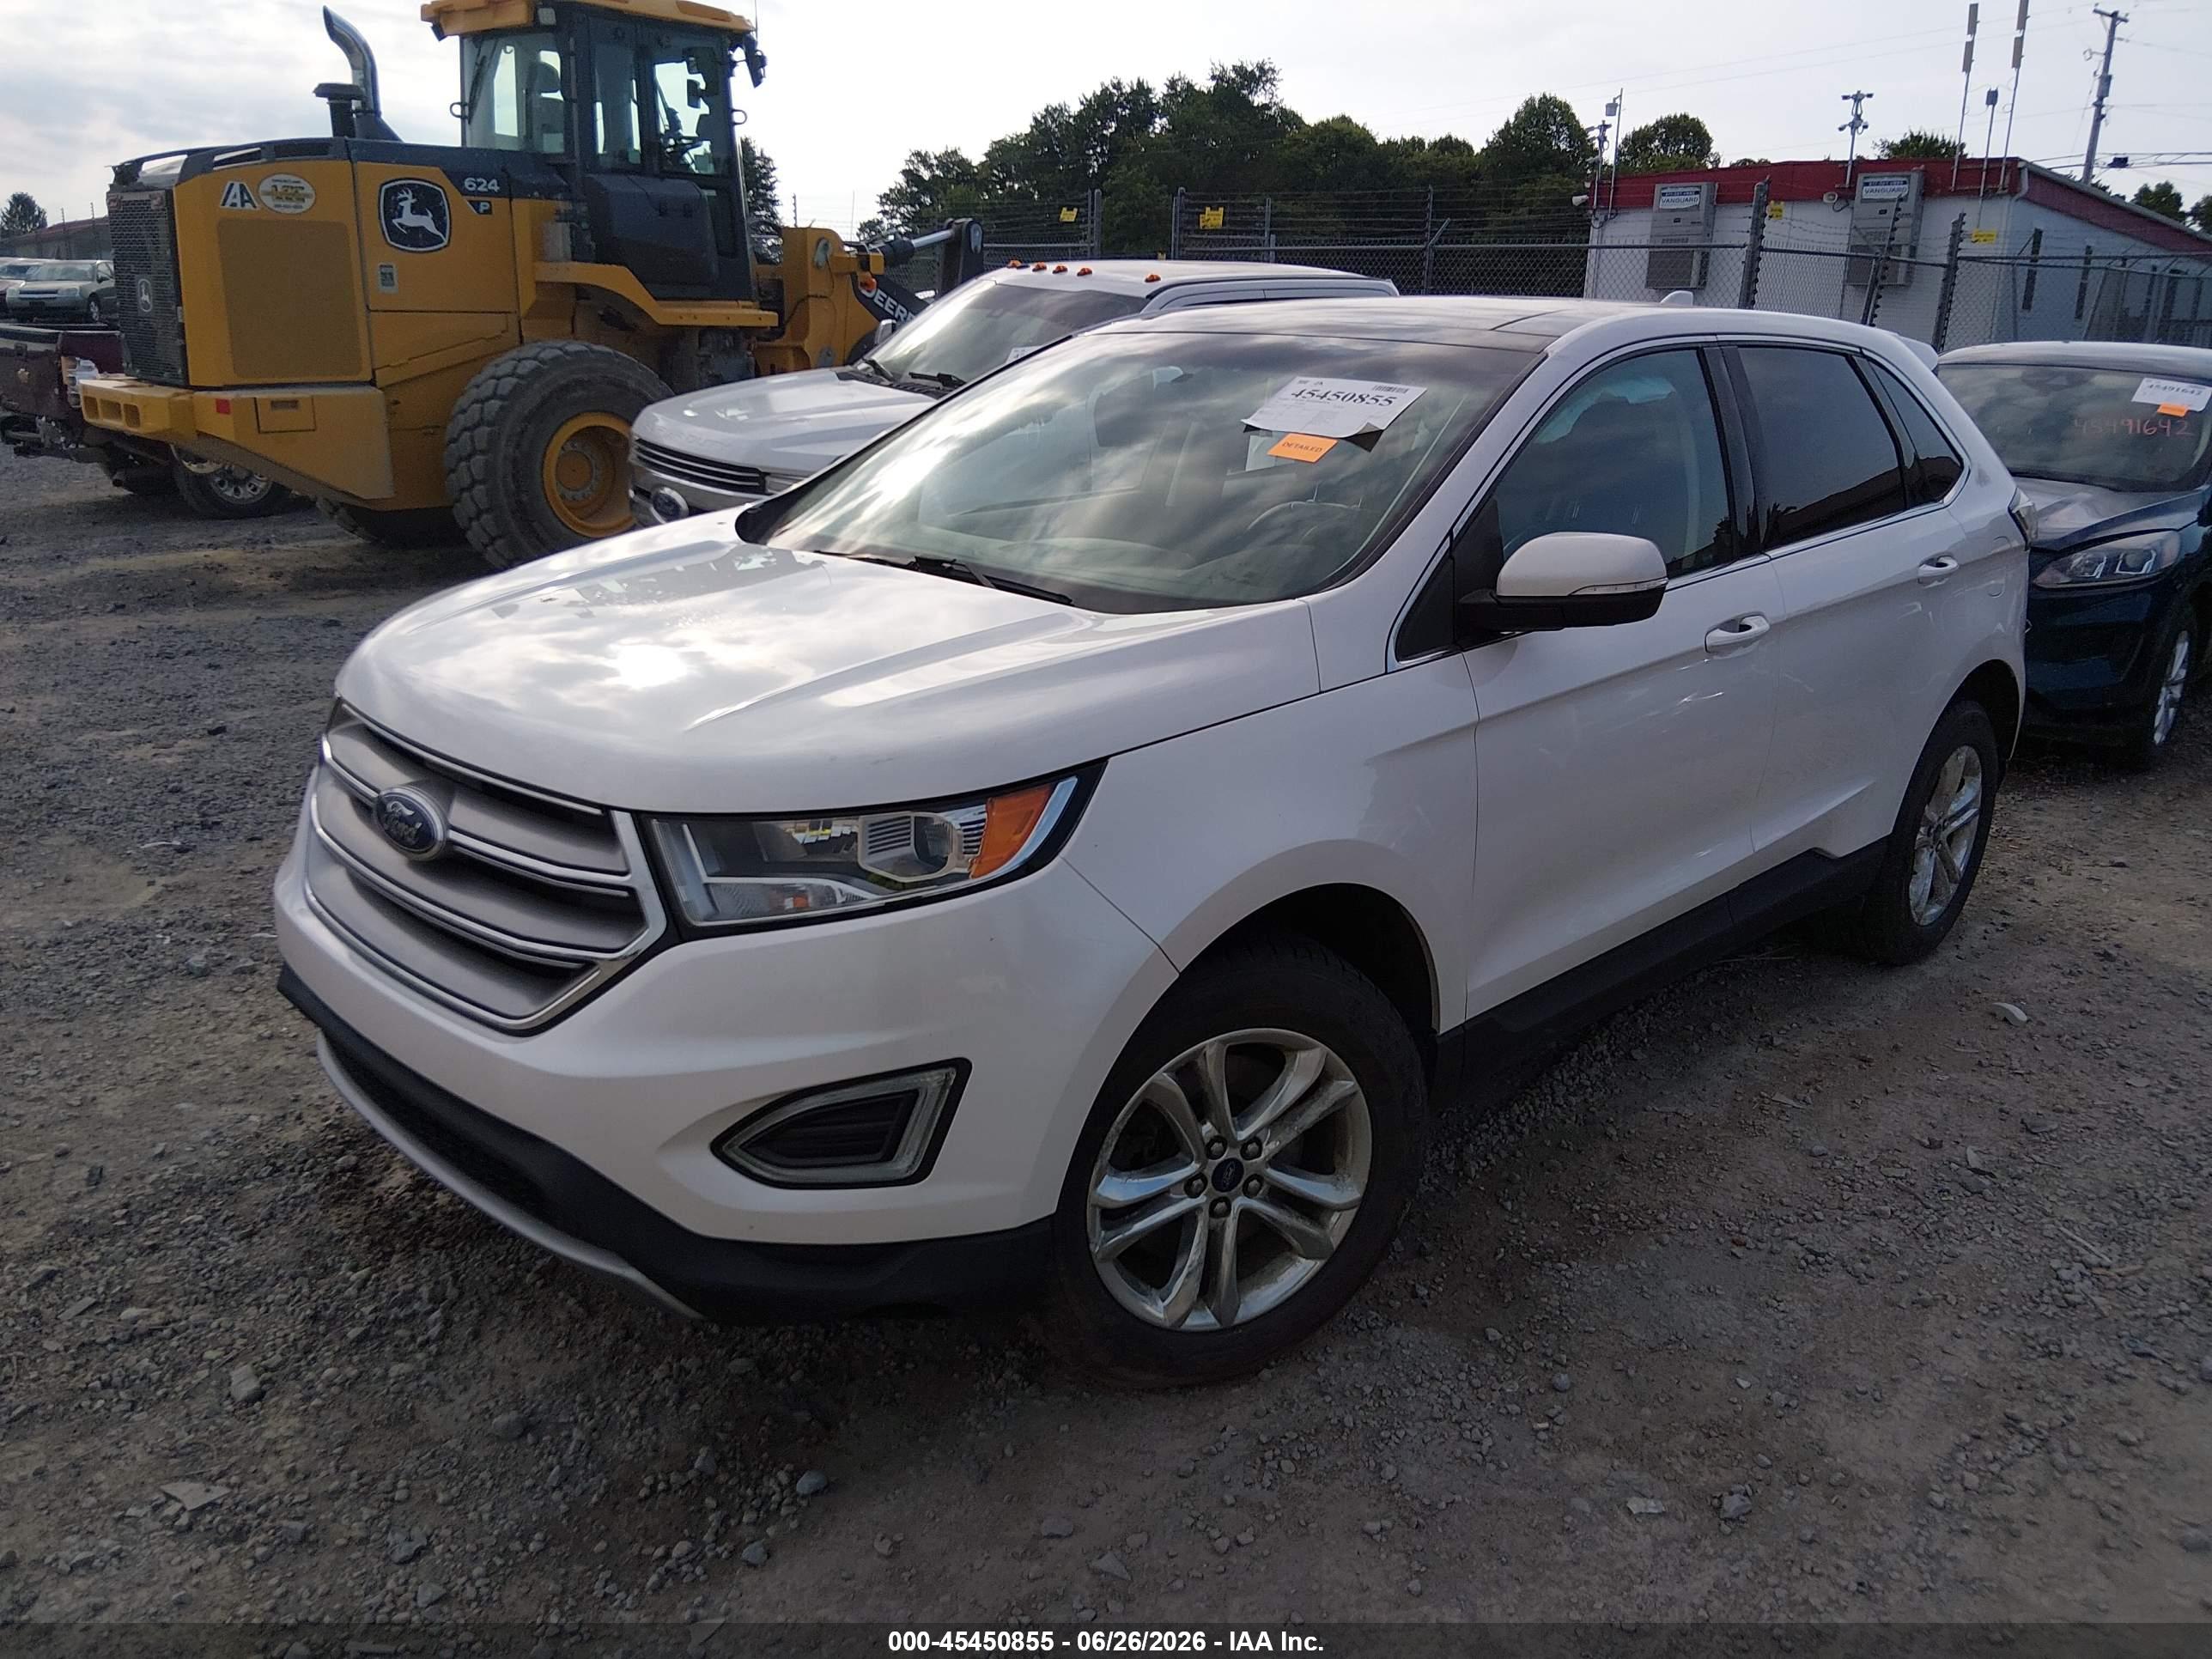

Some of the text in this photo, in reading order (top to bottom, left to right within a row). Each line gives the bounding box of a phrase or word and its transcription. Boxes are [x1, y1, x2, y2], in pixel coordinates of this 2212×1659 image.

[465, 177, 500, 192] 624
[480, 202, 489, 213] P
[1291, 388, 1397, 407] 45450855
[1282, 442, 1322, 453] DETAILED
